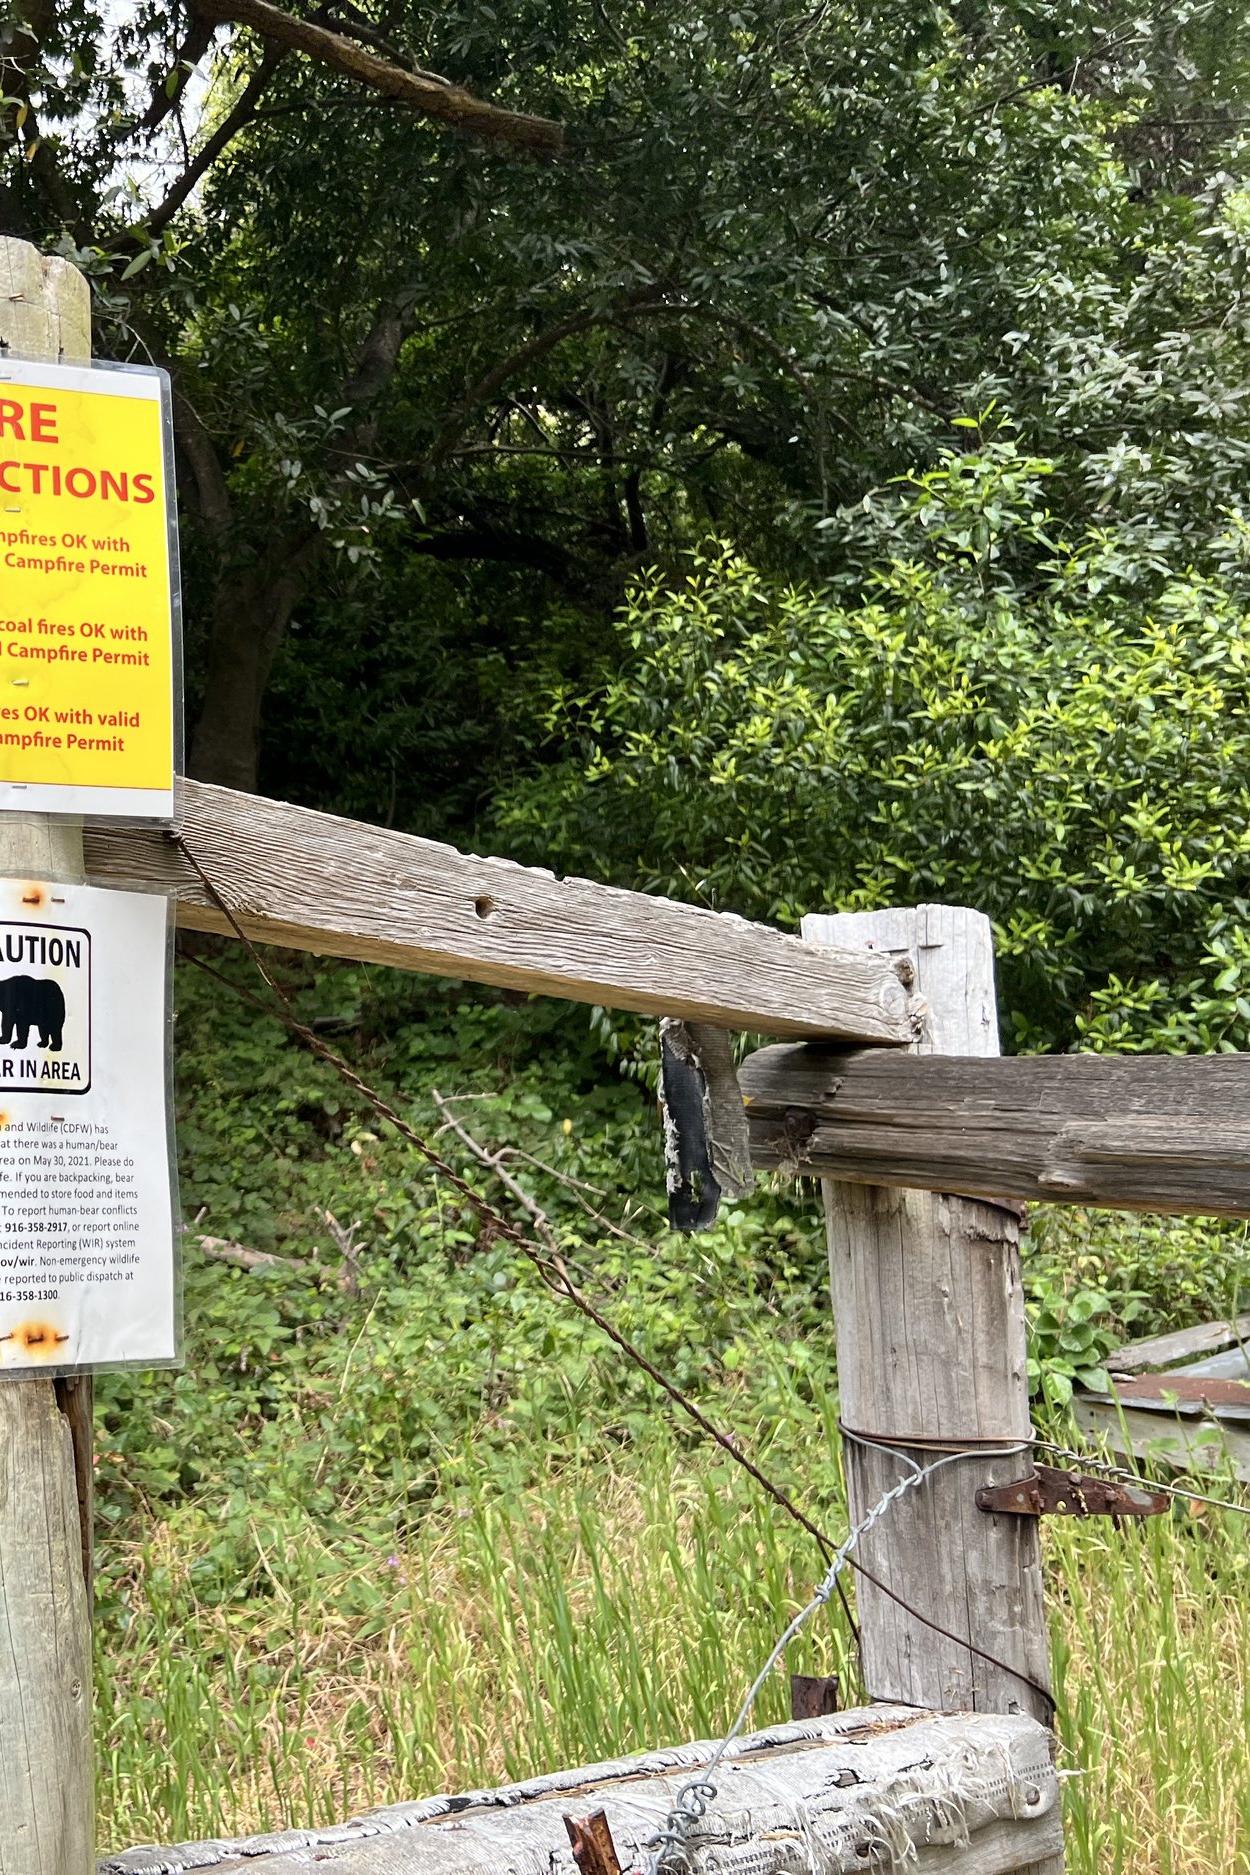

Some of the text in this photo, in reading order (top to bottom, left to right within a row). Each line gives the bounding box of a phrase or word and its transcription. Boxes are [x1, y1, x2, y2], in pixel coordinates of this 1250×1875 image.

[61, 531, 87, 550] OK
[92, 534, 130, 552] with
[4, 552, 85, 575] Campfire
[90, 557, 147, 578] Permit
[37, 618, 75, 637] fires
[80, 620, 105, 638] OK
[110, 623, 148, 641] with
[7, 641, 88, 665] Campfire
[92, 647, 150, 666] Permit
[24, 706, 49, 724] OK
[55, 708, 92, 726] with
[97, 709, 140, 728] valid
[67, 732, 124, 752] Permit
[20, 1060, 36, 1078] IN
[41, 1061, 80, 1080] AREA
[5, 1122, 23, 1132] and
[27, 1122, 58, 1133] Wildlife
[60, 1123, 92, 1135] (CDFW)
[94, 1124, 108, 1134] has
[14, 1139, 39, 1148] there
[66, 1140, 118, 1151] human/bear
[18, 1157, 31, 1165] on
[33, 1156, 51, 1168] May
[54, 1157, 66, 1167] 30,
[68, 1157, 92, 1166] 2021.
[94, 1157, 121, 1167] Please
[123, 1157, 134, 1167] do
[16, 1172, 22, 1181] If
[25, 1174, 41, 1184] you
[44, 1174, 57, 1182] are
[59, 1172, 113, 1184] backpacking,
[116, 1173, 134, 1182] bear
[41, 1189, 49, 1198] to
[51, 1190, 72, 1198] store
[74, 1189, 93, 1198] food
[97, 1189, 112, 1198] and
[115, 1189, 138, 1198] items
[2, 1206, 14, 1215] To
[18, 1207, 46, 1217] report
[49, 1205, 99, 1215] human-bear
[102, 1205, 137, 1215] conflicts
[5, 1222, 70, 1233] 916-358-2917,
[83, 1223, 110, 1233] report
[113, 1221, 139, 1231] online
[37, 1239, 77, 1250] Reporting
[79, 1238, 103, 1250] (WIR)
[106, 1239, 135, 1249] system
[40, 1255, 107, 1267] Non-emergency
[109, 1254, 140, 1264] wildlife
[5, 1273, 46, 1285] reported
[49, 1273, 57, 1283] to
[59, 1272, 84, 1284] public
[87, 1271, 122, 1282] dispatch
[125, 1271, 133, 1280] at
